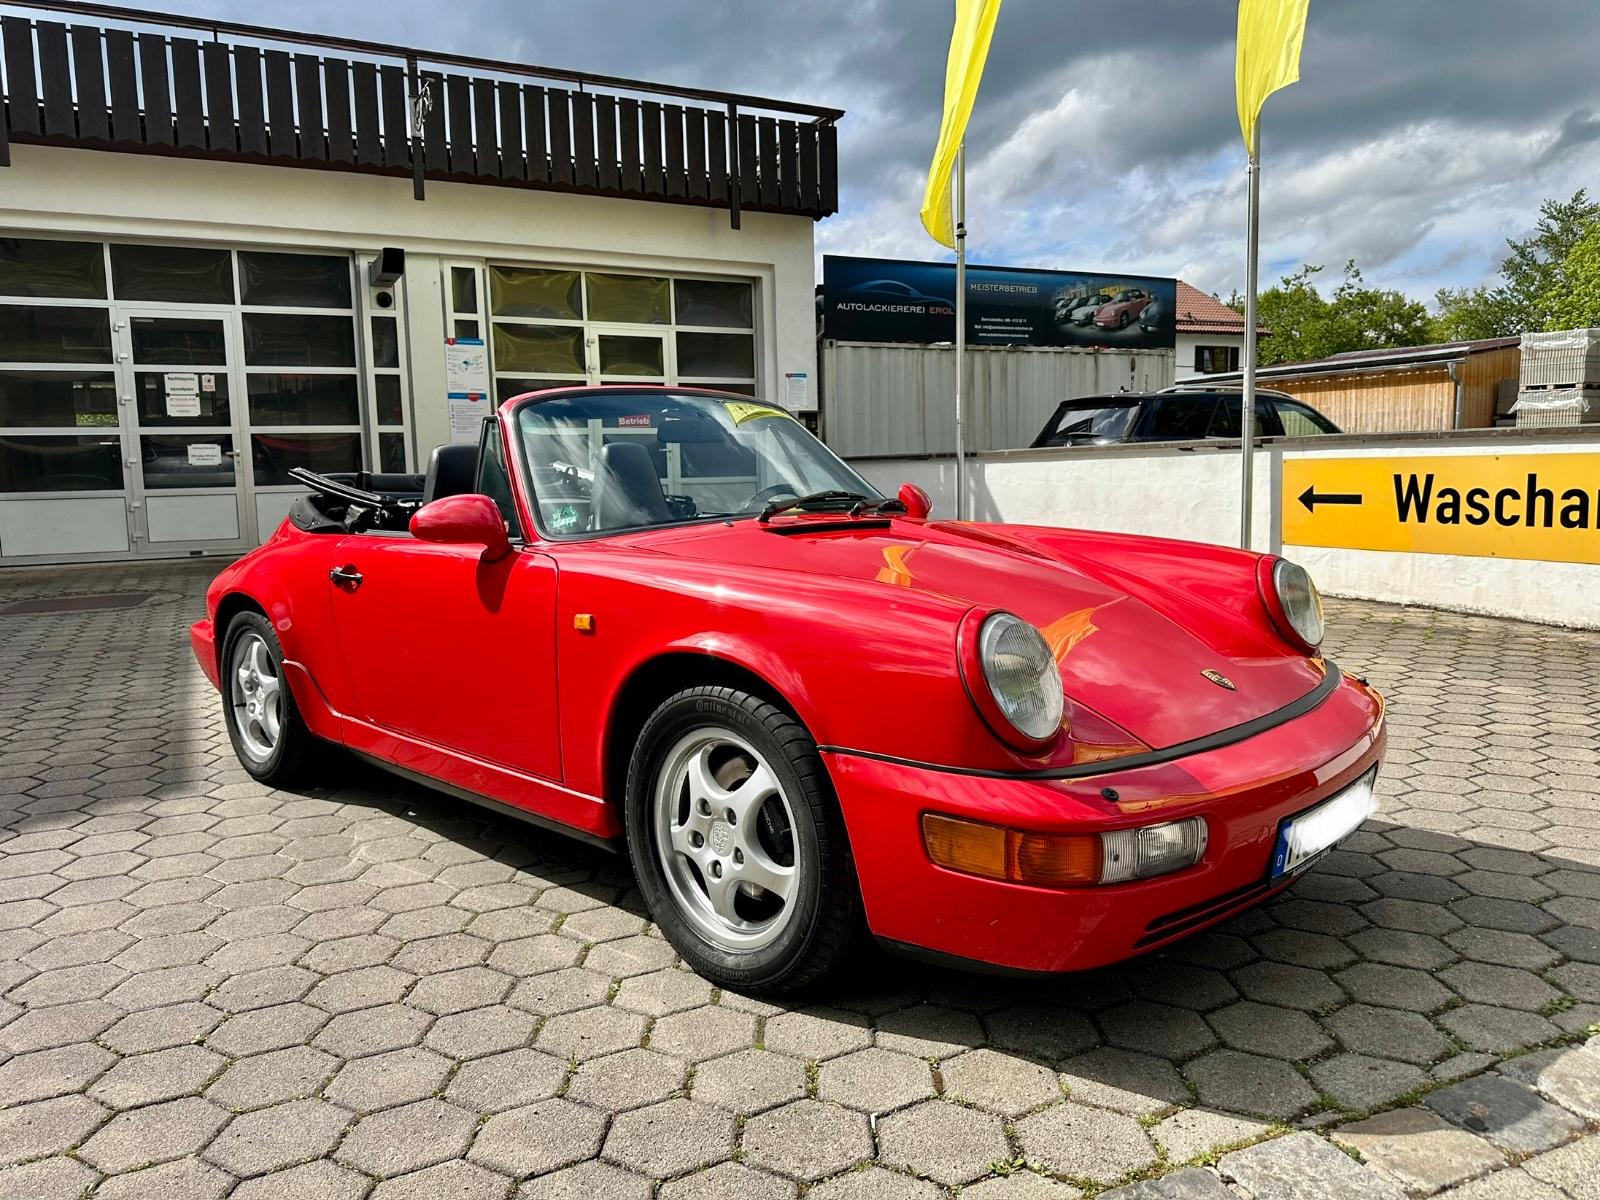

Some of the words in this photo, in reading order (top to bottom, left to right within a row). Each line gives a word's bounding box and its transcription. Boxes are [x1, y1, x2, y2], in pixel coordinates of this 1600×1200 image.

[970, 283, 1038, 294] MEISTERBETRIEB
[837, 303, 925, 314] AUTOLACKIEREREI
[928, 306, 955, 315] EROL
[619, 417, 649, 425] Betrieb
[1393, 473, 1600, 529] Wascha
